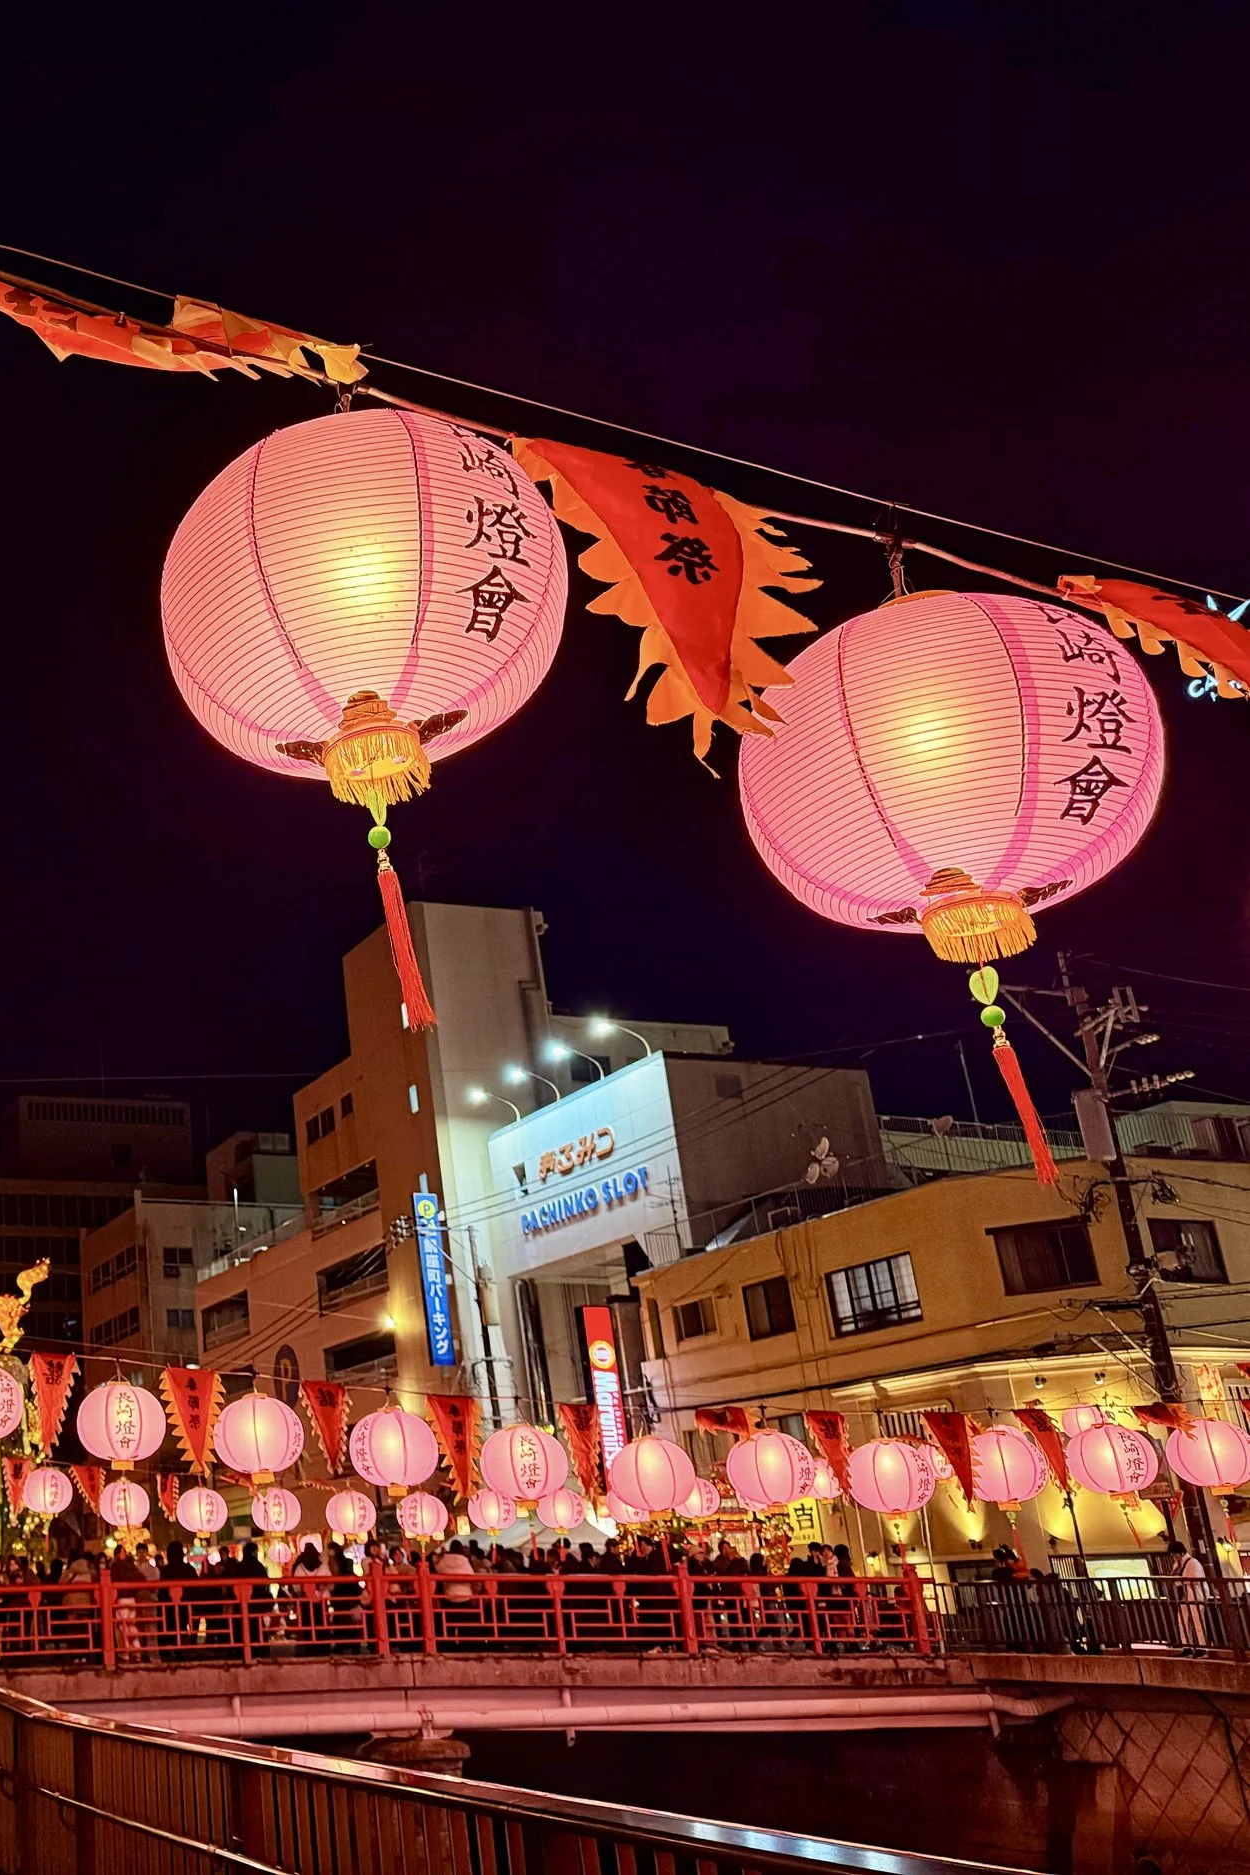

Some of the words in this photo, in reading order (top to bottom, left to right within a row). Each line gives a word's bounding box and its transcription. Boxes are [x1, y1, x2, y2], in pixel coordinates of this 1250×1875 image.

[538, 1127, 615, 1184] まるみつ
[521, 1187, 598, 1235] PACHINKO
[601, 1166, 648, 1205] SLOT
